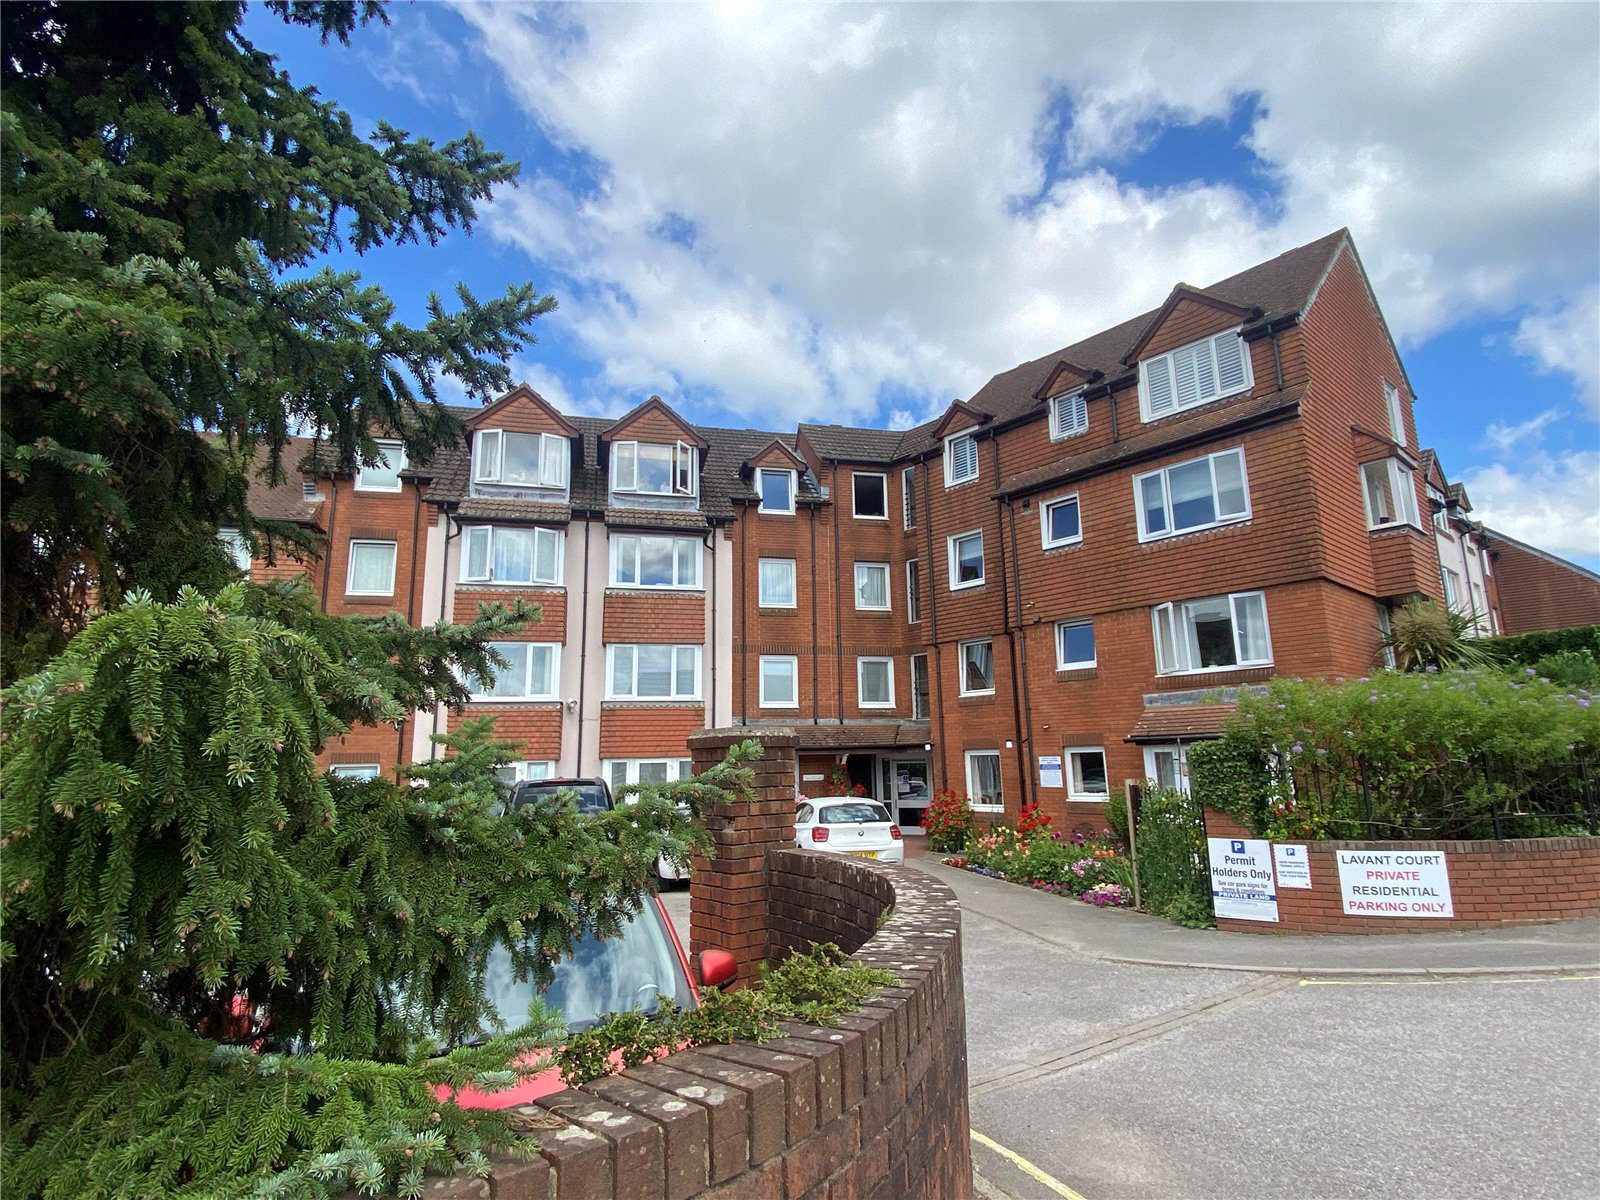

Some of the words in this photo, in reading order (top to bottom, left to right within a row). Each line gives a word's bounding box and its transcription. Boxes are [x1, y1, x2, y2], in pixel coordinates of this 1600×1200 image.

[1224, 856, 1256, 866] Permit
[1342, 855, 1391, 865] LAVANT
[1395, 856, 1440, 866] COURT
[1212, 867, 1248, 878] Holders
[1250, 869, 1272, 882] Only
[1366, 870, 1420, 881] PRIVATE
[1352, 886, 1439, 896] RESIDENTIAL
[1349, 901, 1408, 912] PARKING
[1412, 902, 1446, 912] ONLY
